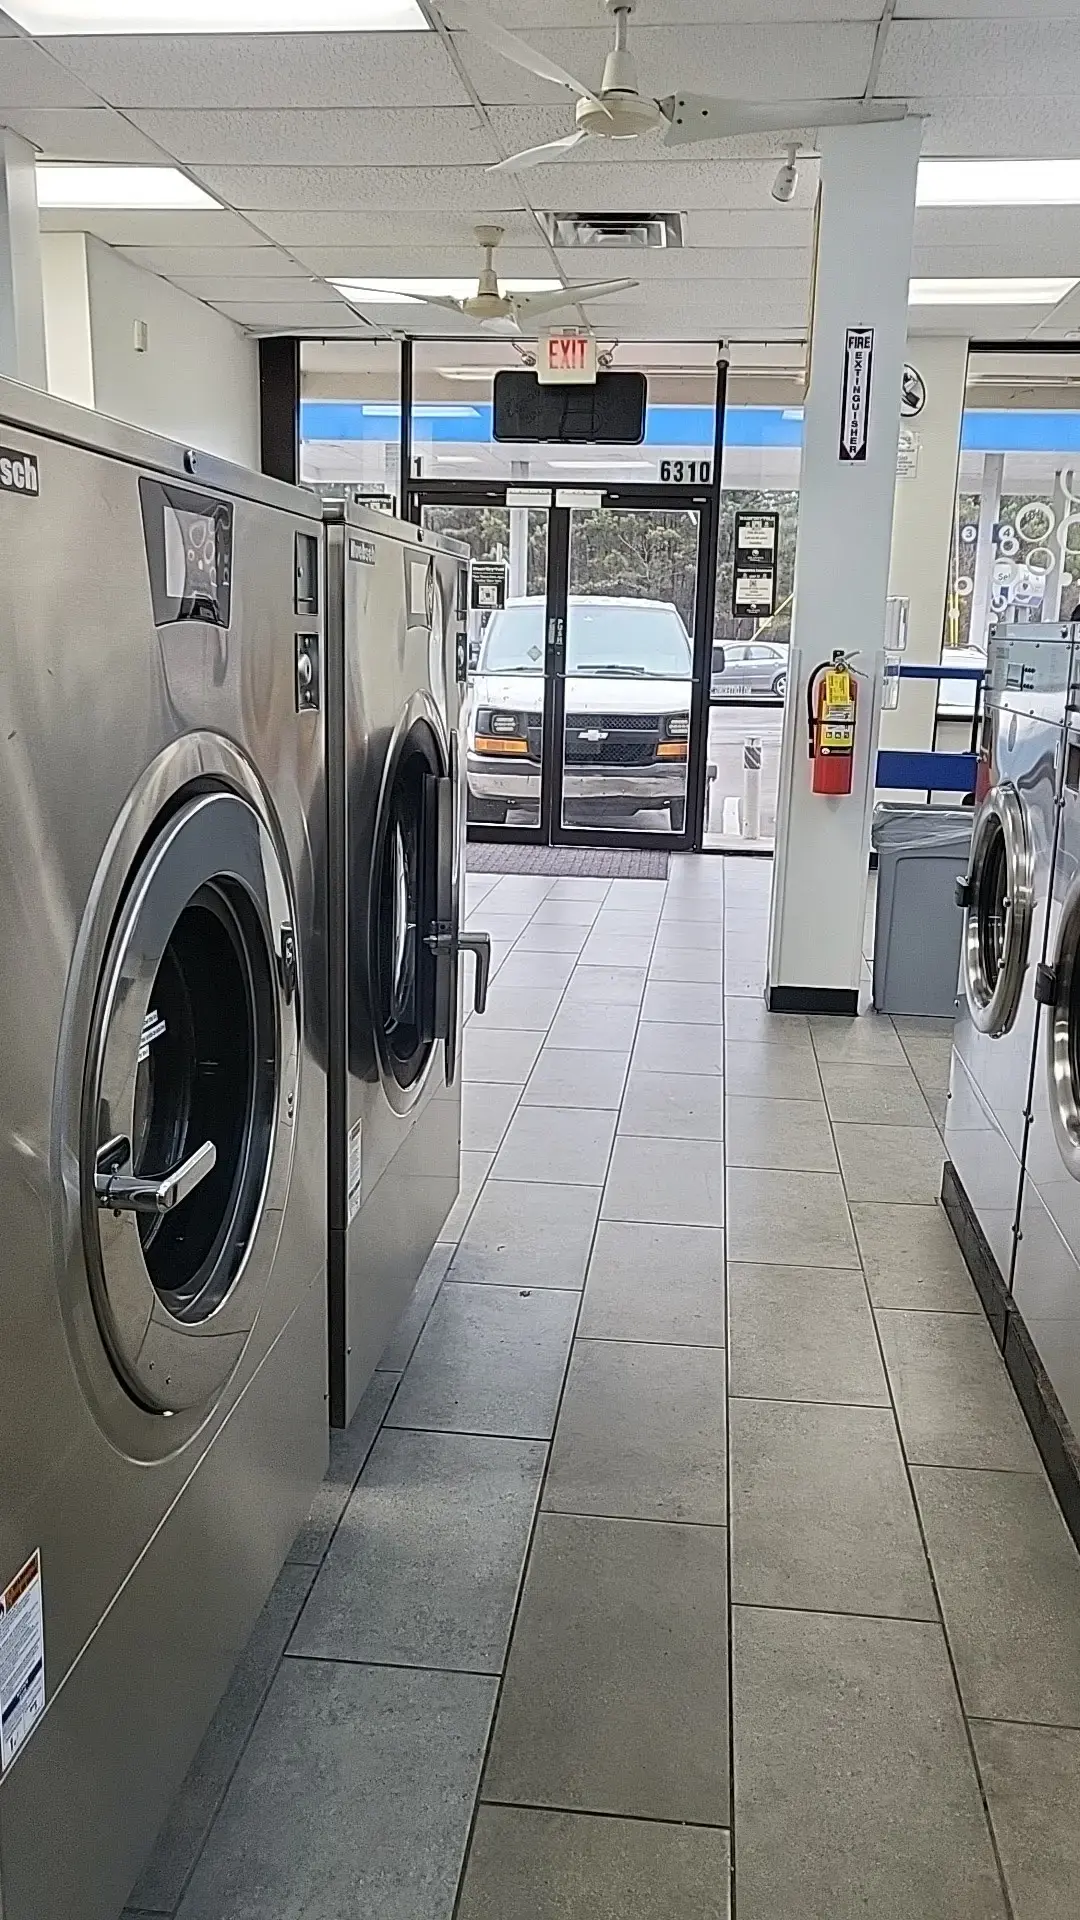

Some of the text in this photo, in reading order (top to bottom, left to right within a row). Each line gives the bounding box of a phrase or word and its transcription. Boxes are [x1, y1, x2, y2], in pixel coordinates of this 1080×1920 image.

[549, 339, 588, 369] EXIT
[848, 336, 871, 349] FIRE
[849, 351, 863, 453] EXTINGUISHER
[660, 460, 710, 483] 6310
